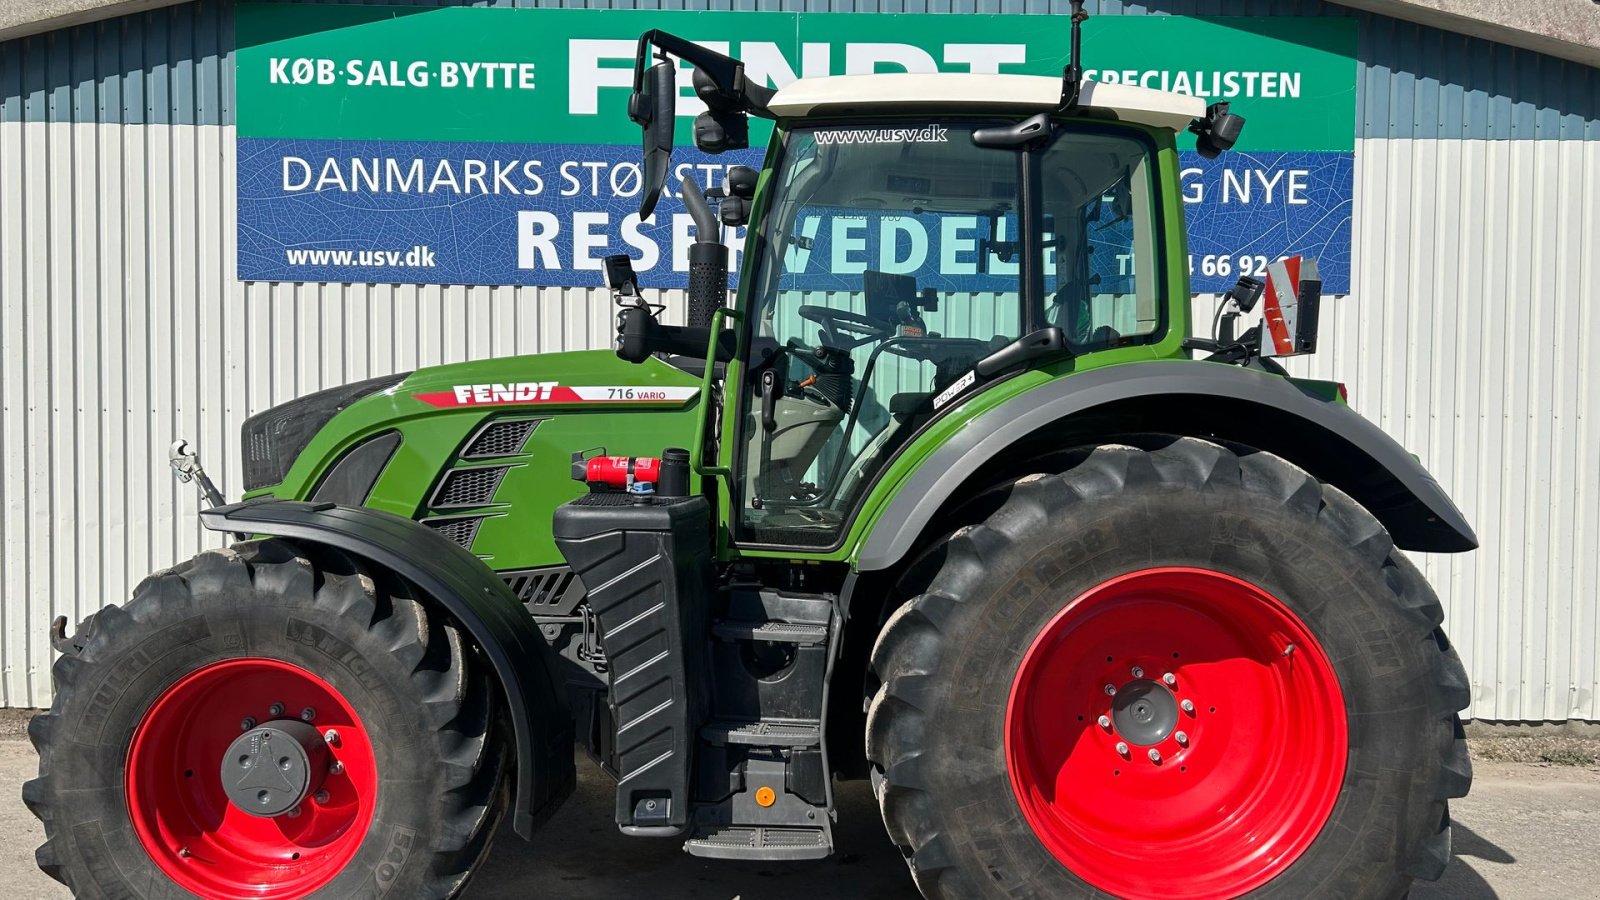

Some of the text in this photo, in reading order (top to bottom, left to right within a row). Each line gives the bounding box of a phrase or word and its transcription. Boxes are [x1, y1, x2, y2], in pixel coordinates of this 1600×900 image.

[814, 124, 948, 144] www.usv.dk
[282, 156, 544, 196] DANMARKS
[1223, 169, 1309, 204] NYE
[286, 246, 436, 268] www.usv.dk
[1201, 254, 1231, 277] 66
[1239, 255, 1268, 277] 92
[453, 381, 666, 404] FENDT 716 VARIO
